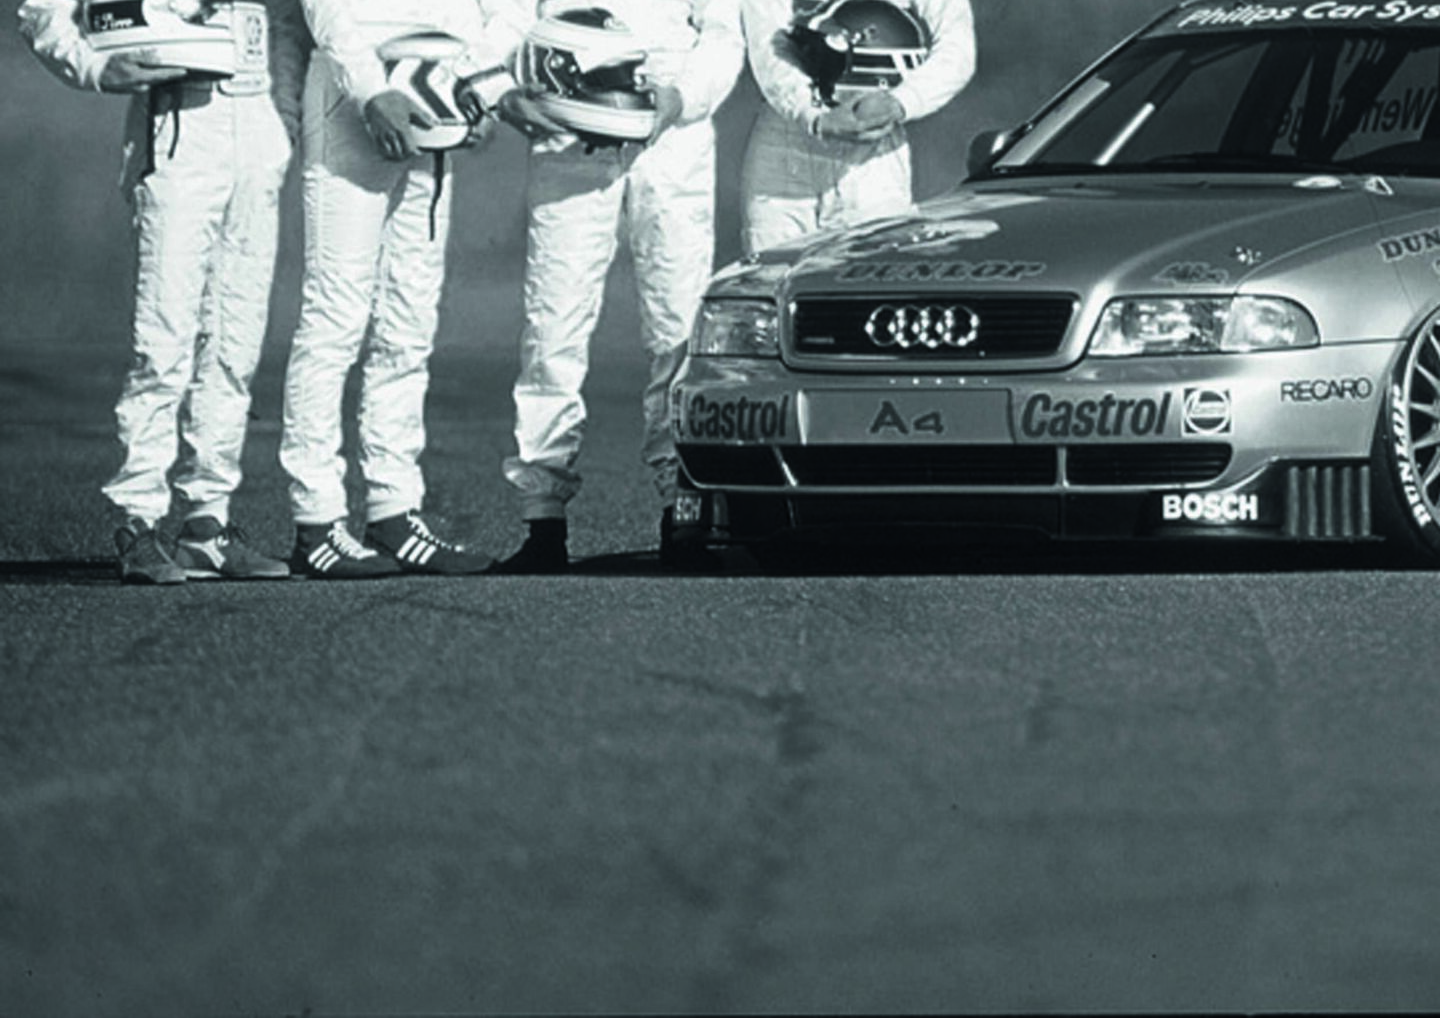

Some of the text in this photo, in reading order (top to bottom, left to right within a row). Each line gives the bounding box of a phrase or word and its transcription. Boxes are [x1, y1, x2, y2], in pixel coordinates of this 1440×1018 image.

[1177, 4, 1298, 29] Philips
[1302, 0, 1376, 20] Car
[1281, 377, 1373, 402] RECARO
[688, 394, 789, 439] Castrol
[1021, 392, 1173, 439] Castrol
[1392, 384, 1431, 527] DUNLOP
[1162, 492, 1258, 521] BOSCH
